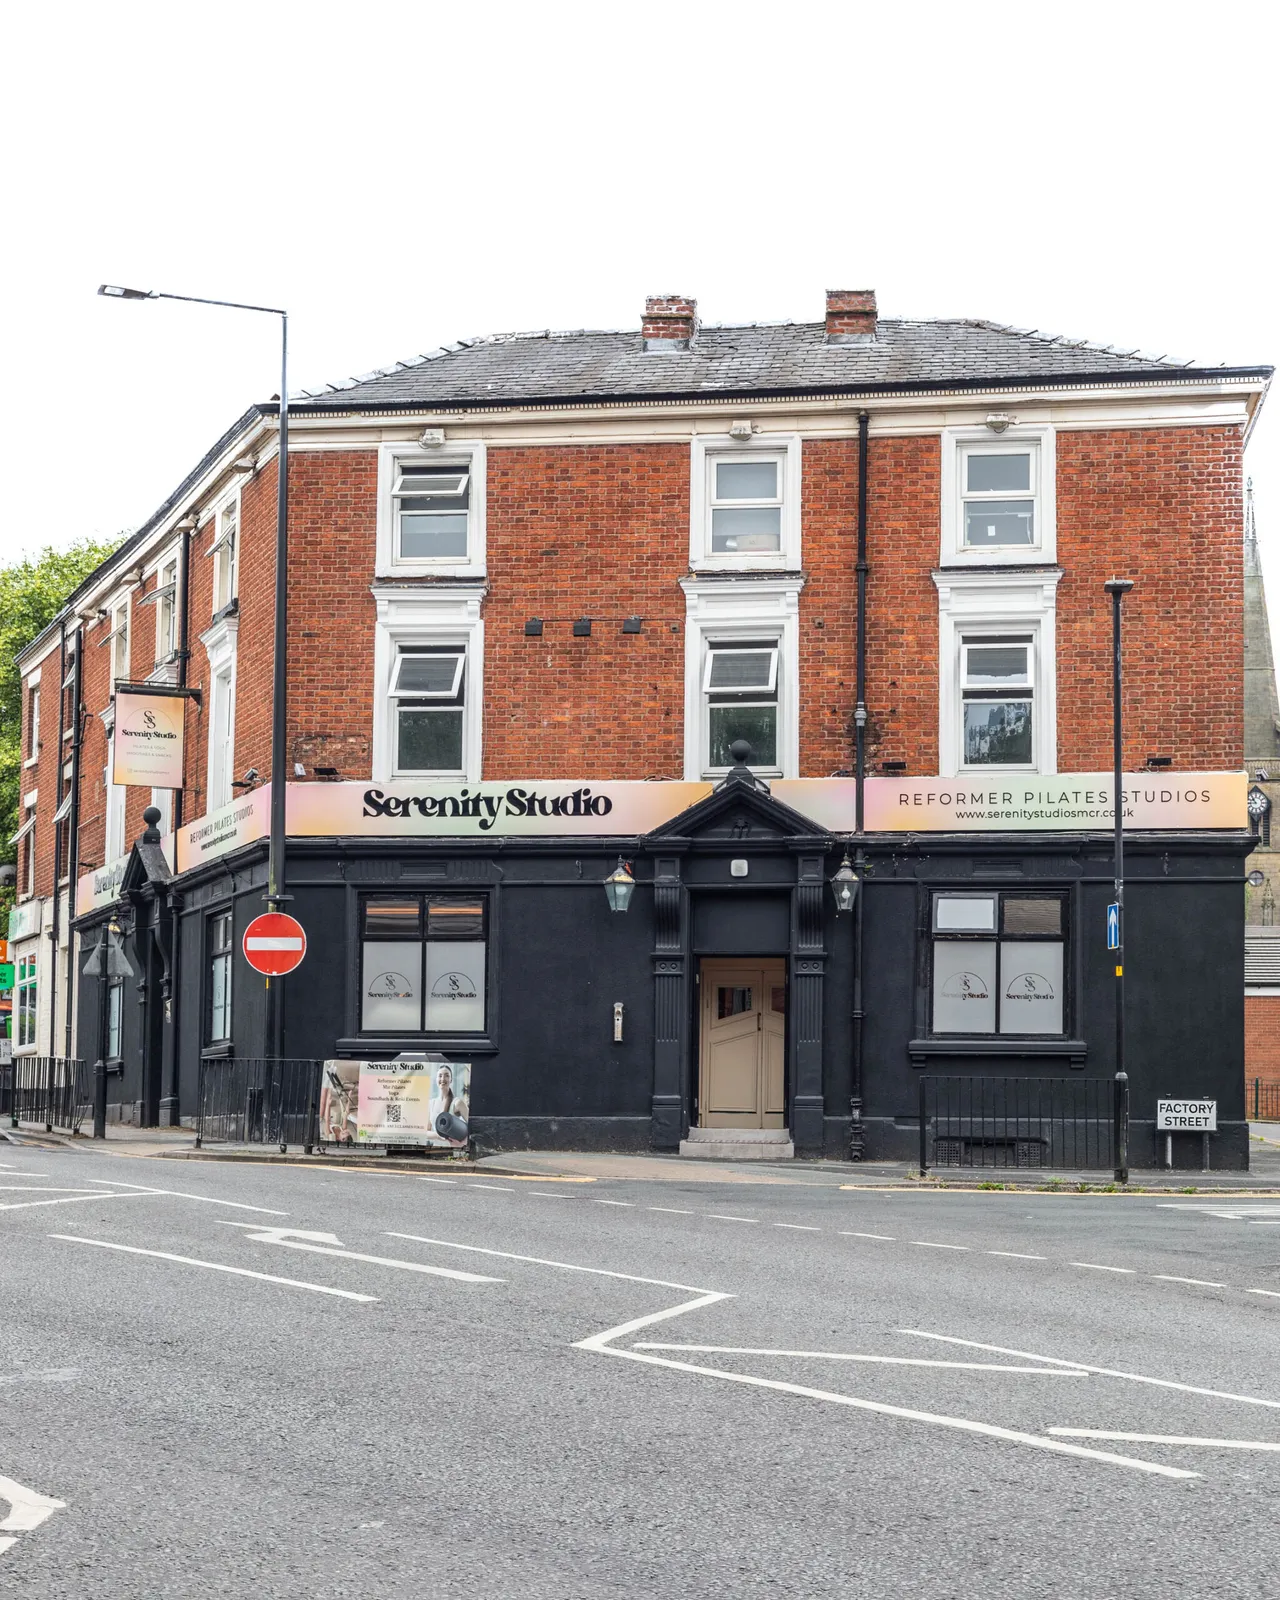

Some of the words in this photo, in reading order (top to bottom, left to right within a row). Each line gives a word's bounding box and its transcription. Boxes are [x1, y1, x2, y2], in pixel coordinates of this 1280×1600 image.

[122, 729, 153, 740] Serenity
[153, 731, 177, 739] Studio
[899, 792, 1013, 806] REFORMER
[1024, 791, 1108, 805] PILATES
[1121, 790, 1211, 804] STUDIOS
[363, 788, 504, 830] Serenity
[505, 788, 613, 817] Studio
[190, 824, 213, 844] REFORMER
[214, 814, 233, 832] PILATES
[233, 804, 254, 824] STUDIOS
[368, 992, 393, 1000] Serenity
[431, 992, 456, 1000] Serenity
[1006, 993, 1033, 1002] Serenity
[367, 1062, 398, 1074] Serenity
[400, 1062, 424, 1071] Studio
[1159, 1103, 1214, 1114] FACTORY
[1164, 1116, 1210, 1127] STREET
